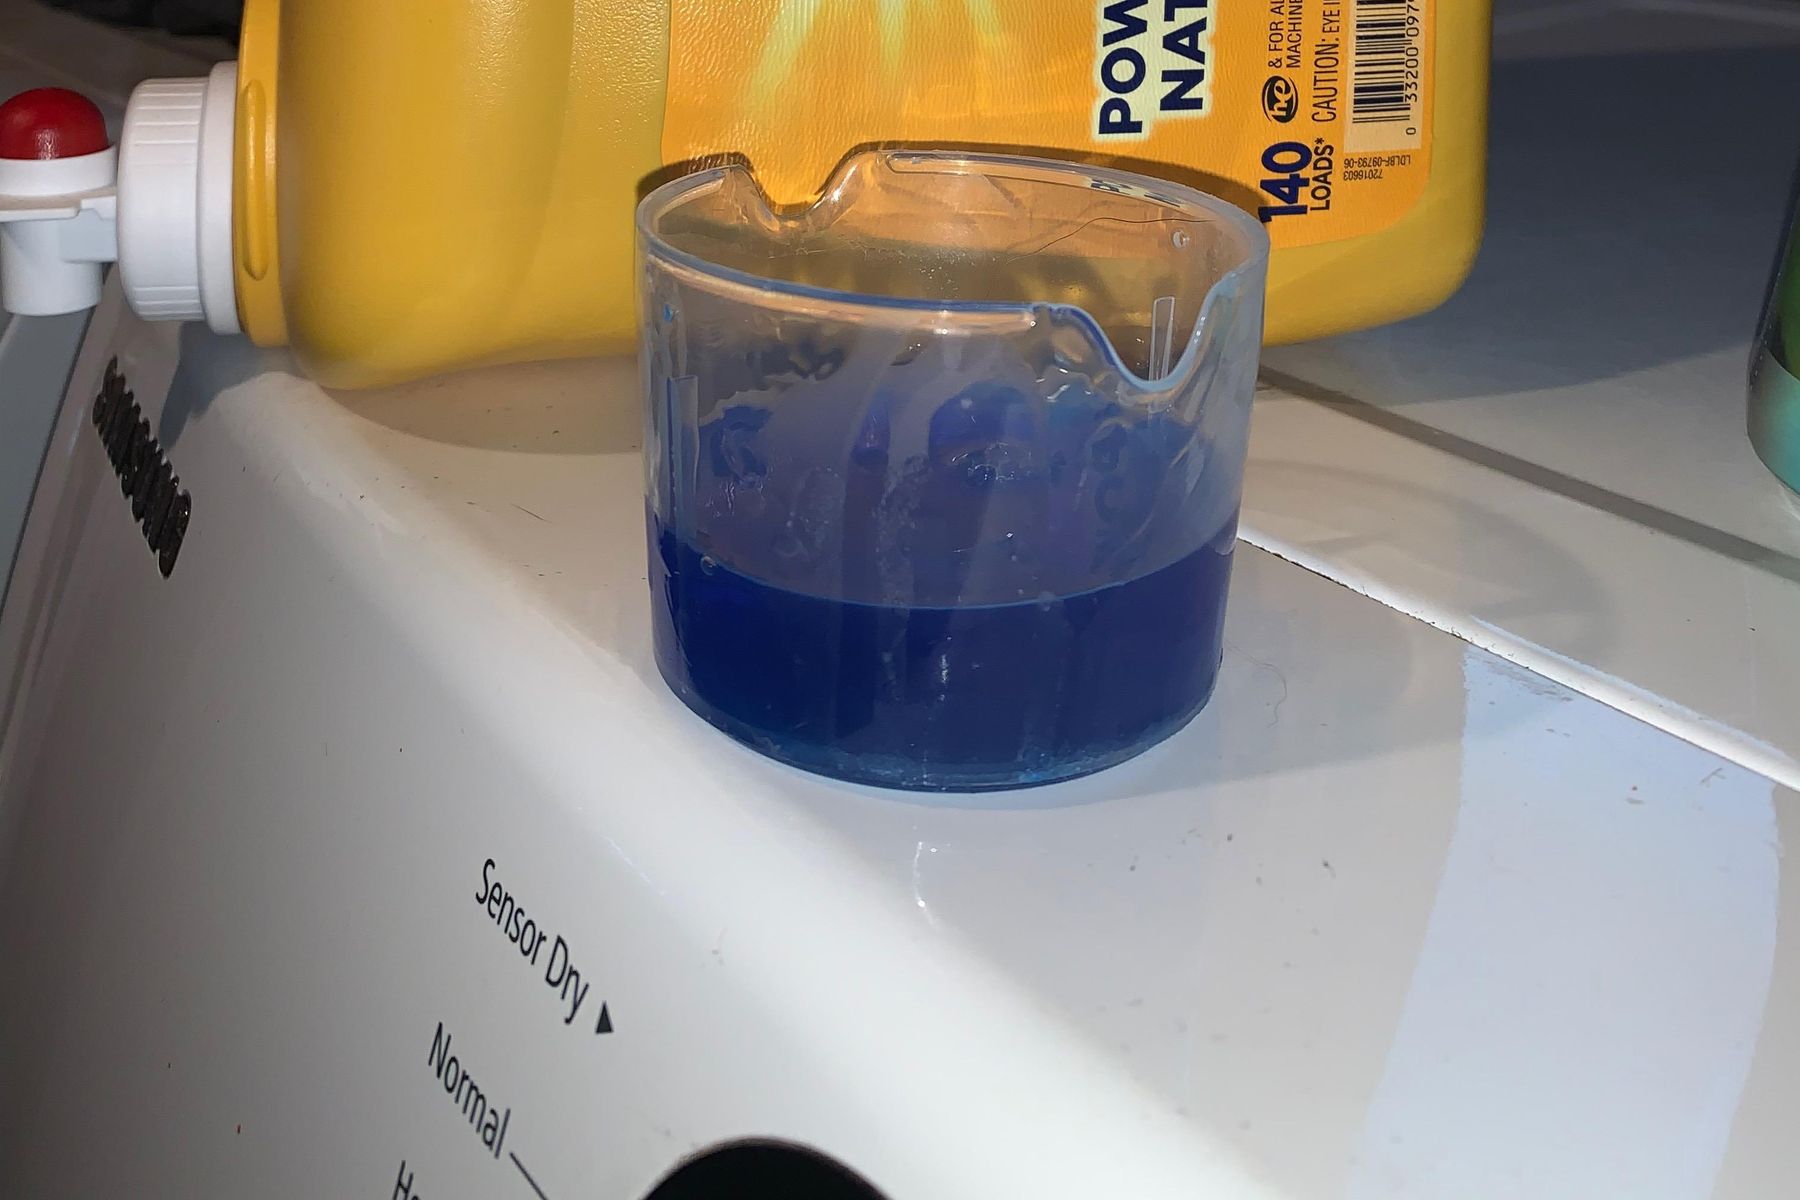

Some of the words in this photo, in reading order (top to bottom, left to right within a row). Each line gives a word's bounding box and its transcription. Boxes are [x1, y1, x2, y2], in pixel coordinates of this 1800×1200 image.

[1269, 21, 1284, 54] FOR
[1323, 9, 1340, 33] EYE
[1267, 58, 1283, 69] &
[1312, 38, 1339, 122] CAUTION:
[1405, 46, 1418, 102] 33200
[1406, 127, 1416, 135] 0
[1258, 141, 1313, 223] 140
[476, 858, 547, 966] Sensor
[545, 935, 590, 1025] Dry
[428, 1022, 511, 1159] Normal
